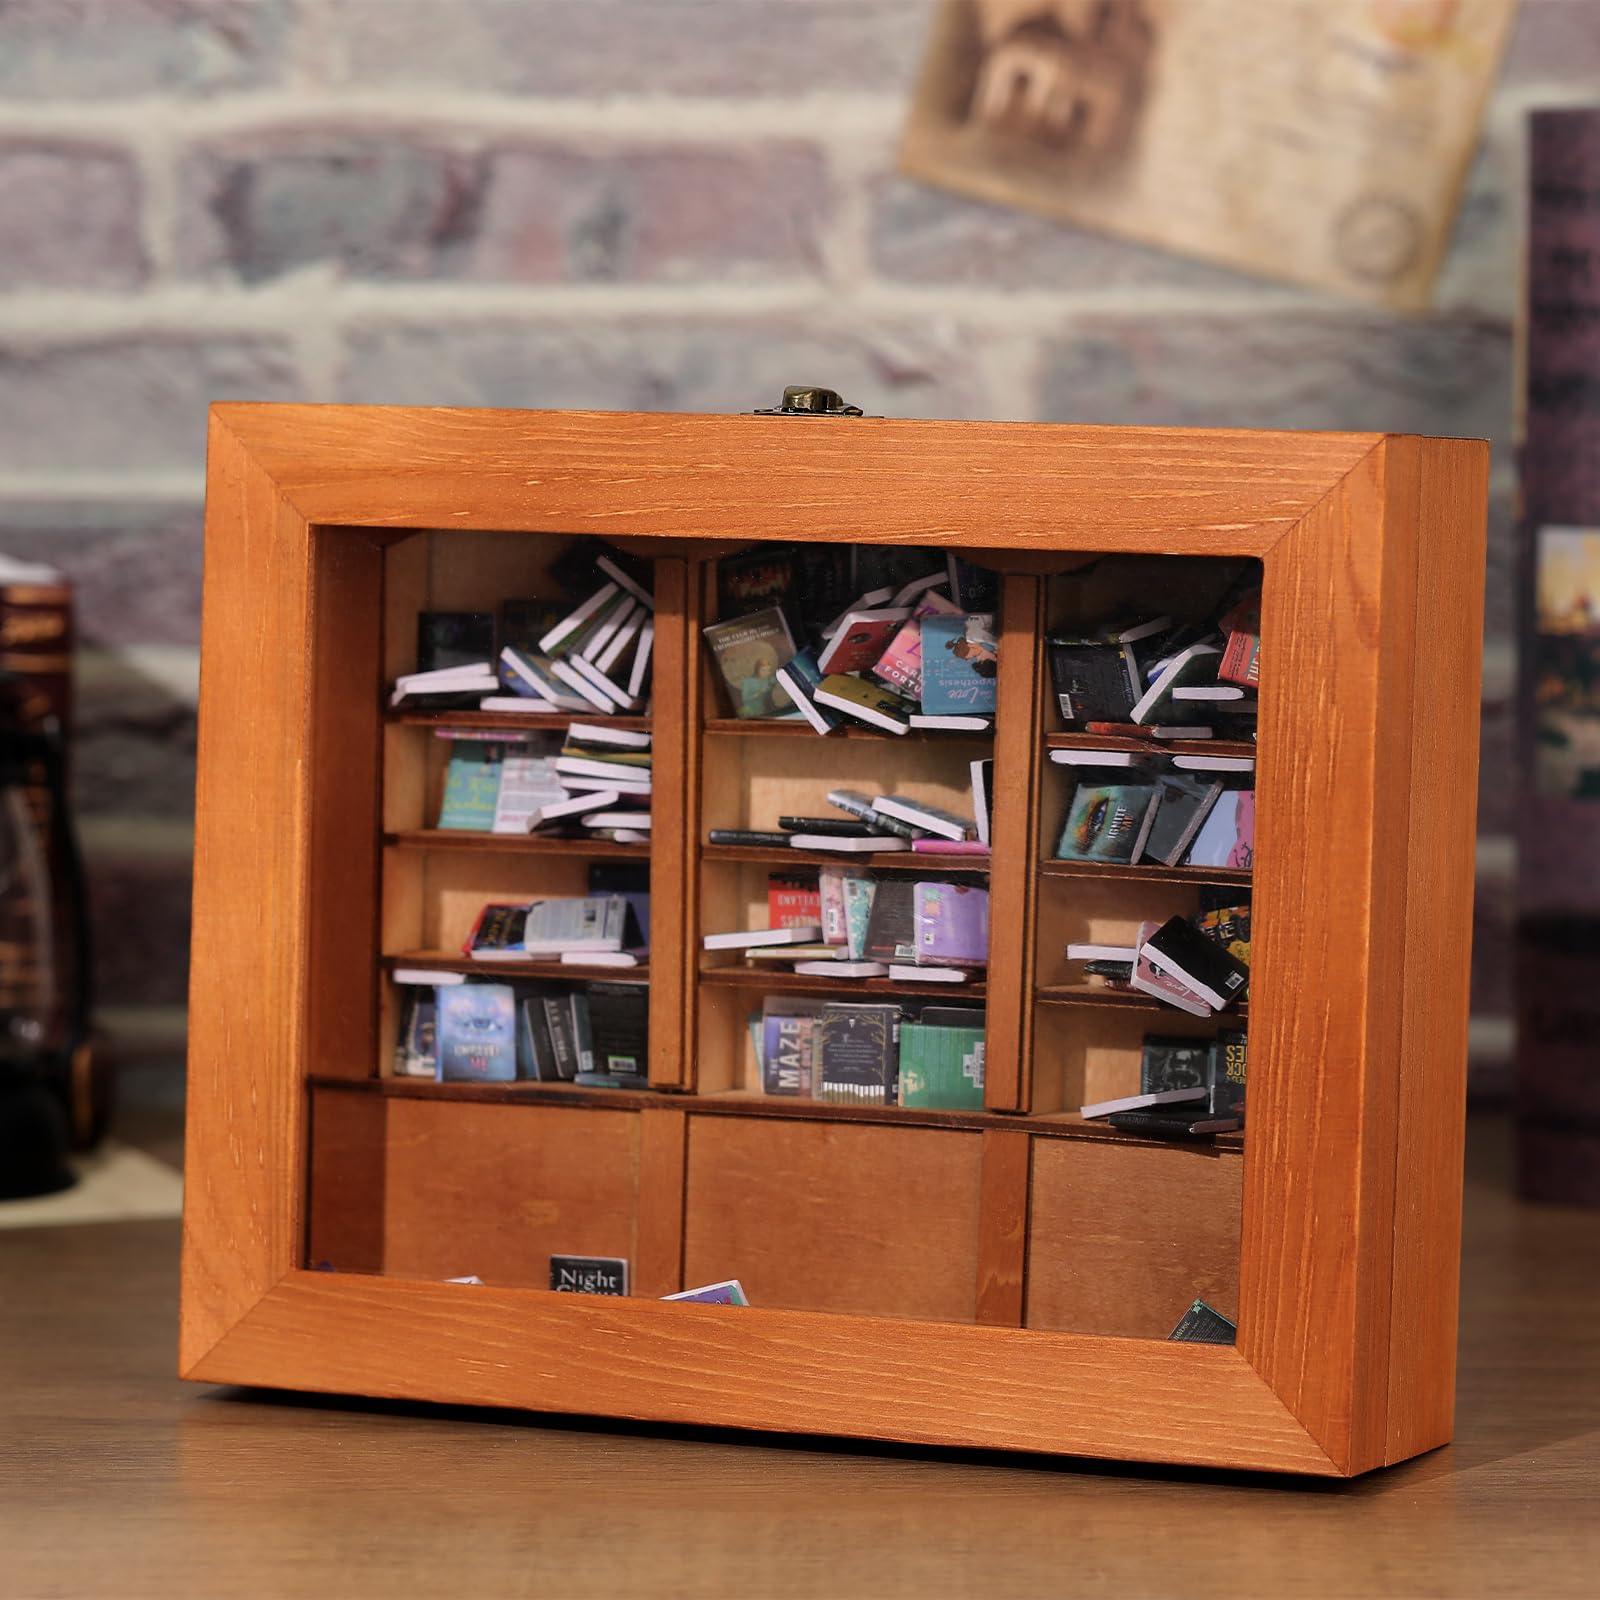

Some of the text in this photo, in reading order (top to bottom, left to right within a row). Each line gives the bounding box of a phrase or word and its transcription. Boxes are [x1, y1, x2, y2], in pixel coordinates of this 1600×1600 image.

[884, 665, 922, 694] FORTU
[1108, 805, 1128, 840] IGNITE
[778, 1022, 801, 1088] MAZE
[559, 1267, 617, 1290] Night
